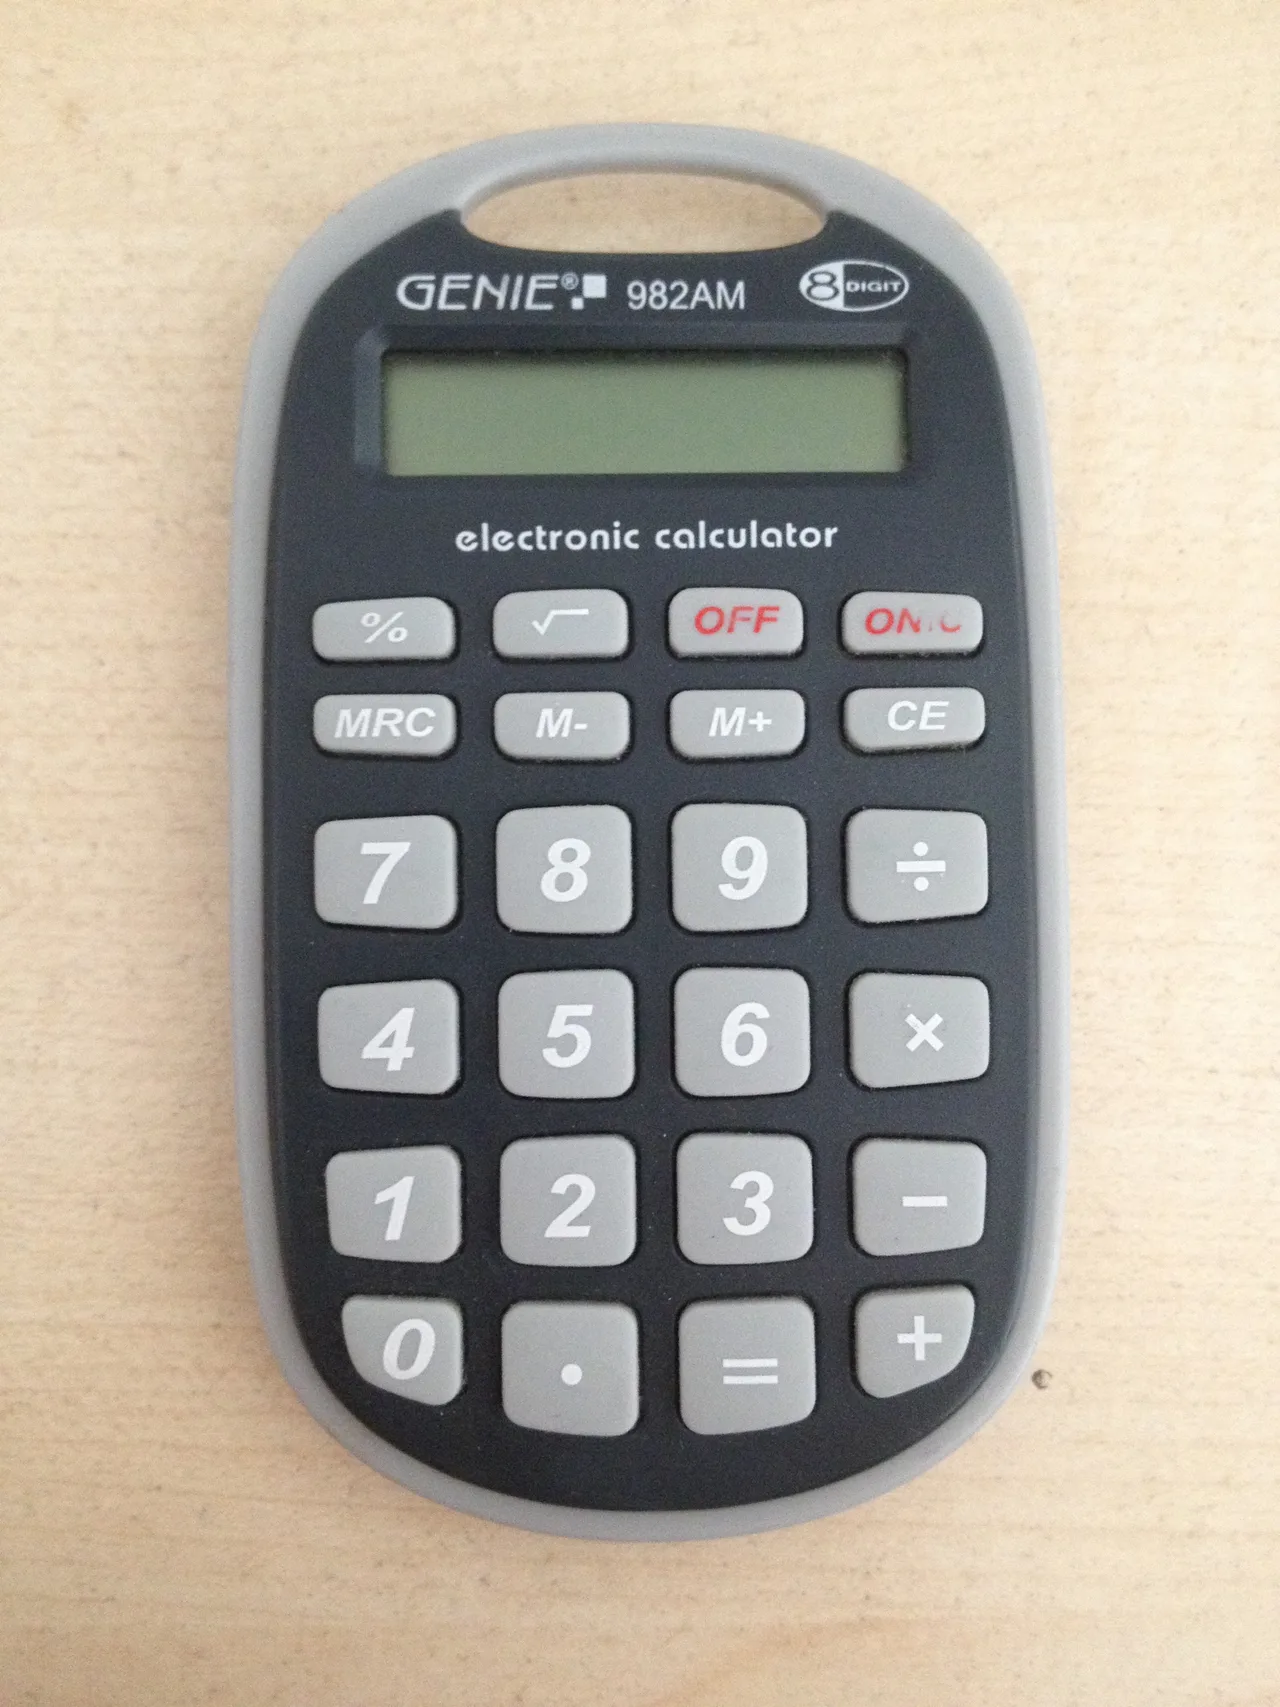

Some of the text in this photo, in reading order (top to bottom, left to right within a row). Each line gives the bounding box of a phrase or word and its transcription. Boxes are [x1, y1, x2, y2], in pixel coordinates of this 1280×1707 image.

[627, 280, 746, 311] 982AM
[806, 271, 901, 301] 8 DIGIT
[455, 520, 839, 552] electronic calculator
[693, 605, 780, 634] OFF
[334, 707, 436, 739] MRC
[535, 708, 588, 738] M-
[708, 706, 772, 737] M+
[886, 700, 949, 731] CE
[359, 841, 411, 905] 7
[540, 838, 591, 902] 8
[718, 836, 769, 901] 9
[362, 1007, 416, 1071] 4
[542, 1004, 594, 1068] 5
[720, 1002, 770, 1066] 6
[373, 1175, 414, 1241] 1
[544, 1174, 596, 1238] 2
[723, 1170, 774, 1235] 3
[382, 1318, 436, 1379] 0
